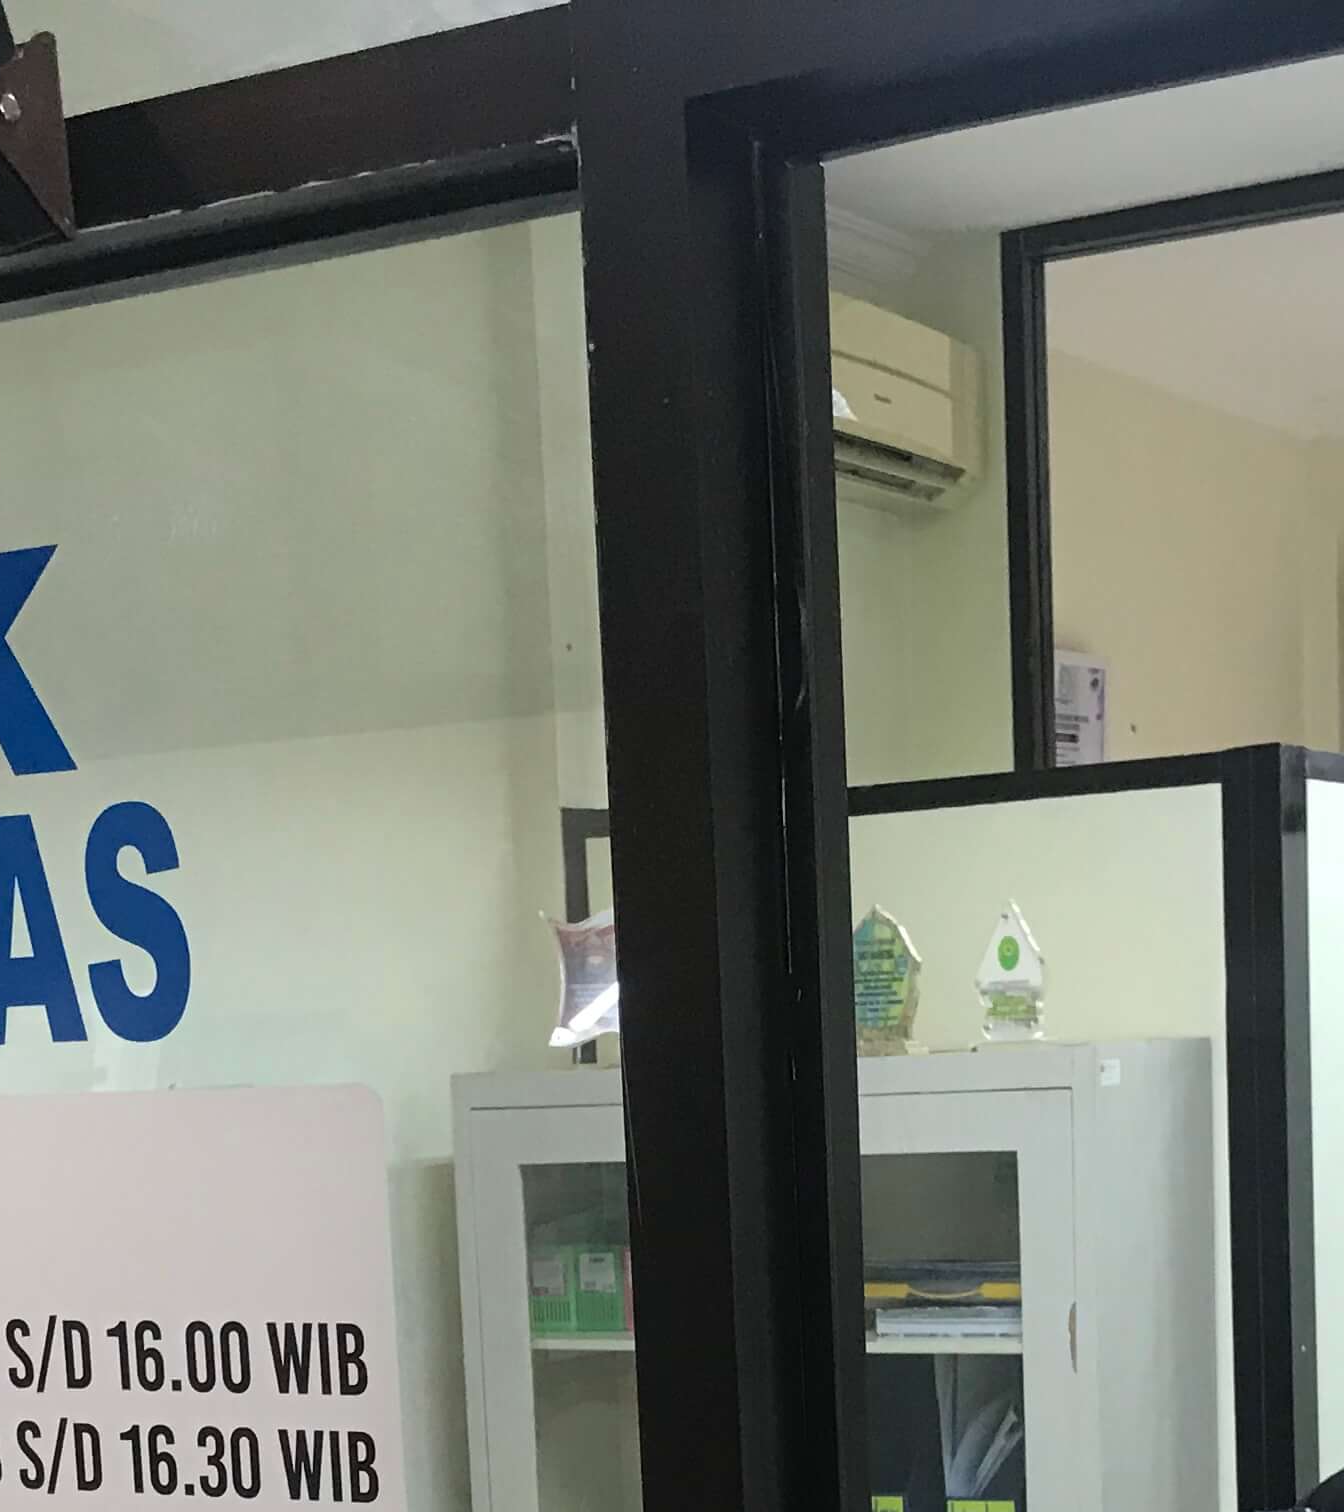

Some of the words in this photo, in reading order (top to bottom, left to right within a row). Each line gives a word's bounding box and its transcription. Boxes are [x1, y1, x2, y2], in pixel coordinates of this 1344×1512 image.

[6, 1315, 92, 1393] S/D
[107, 1320, 251, 1394] 16.00
[266, 1322, 369, 1396] WIB
[16, 1417, 103, 1494] S/D
[120, 1424, 262, 1499] 16.30
[278, 1428, 380, 1503] WIB
